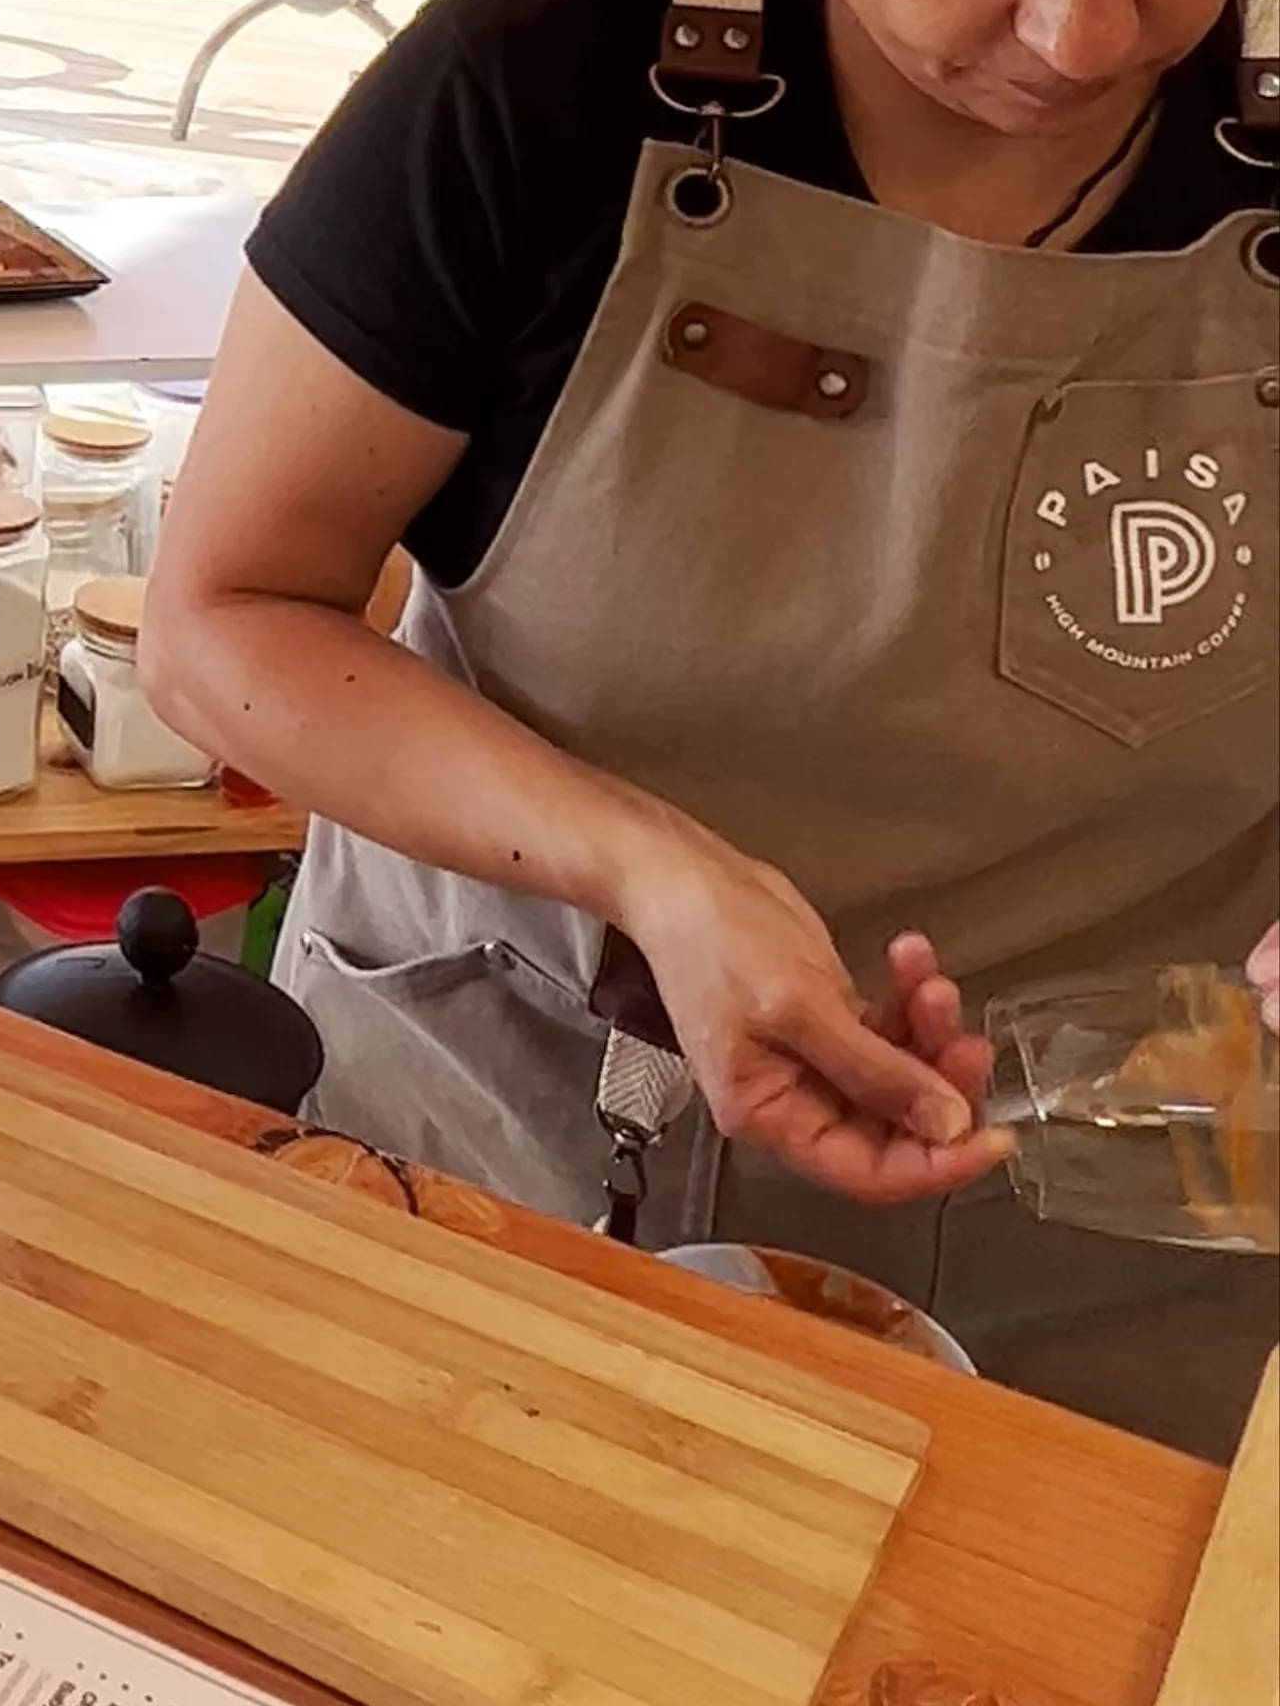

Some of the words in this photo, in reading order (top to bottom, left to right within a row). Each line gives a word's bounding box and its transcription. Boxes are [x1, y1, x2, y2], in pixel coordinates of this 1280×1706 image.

[1035, 447, 1248, 529] PAISA
[1045, 593, 1086, 642] HIGH
[1085, 637, 1194, 671] MOUNTAIN
[1196, 591, 1248, 655] COFFEE
